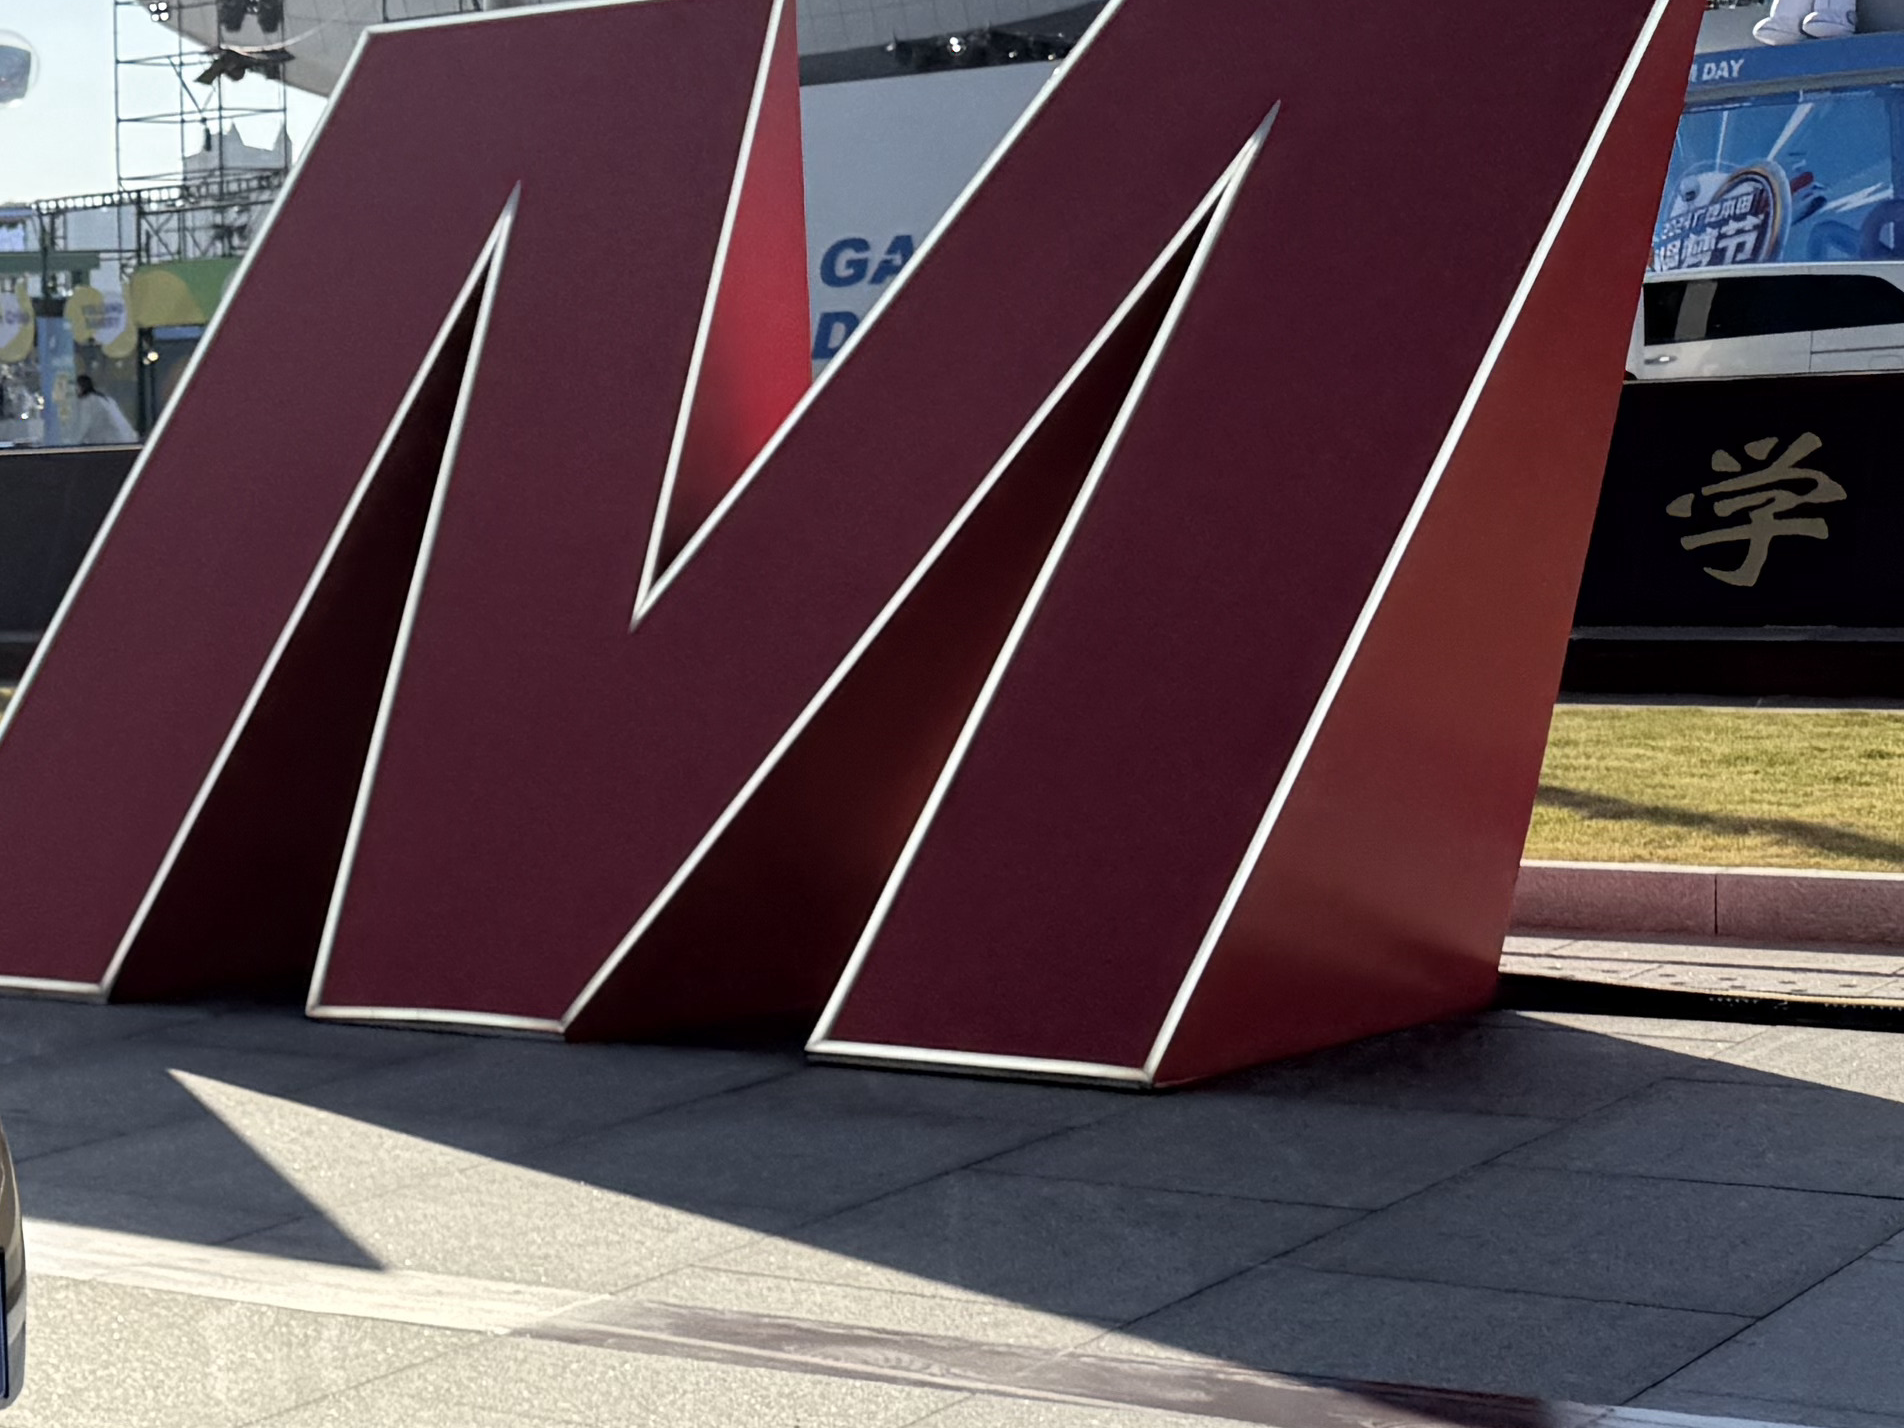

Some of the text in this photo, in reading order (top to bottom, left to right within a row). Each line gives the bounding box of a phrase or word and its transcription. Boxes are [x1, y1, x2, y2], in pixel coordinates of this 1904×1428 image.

[1702, 59, 1744, 81] DAY
[819, 233, 924, 289] GA
[1666, 430, 1848, 588] 学
